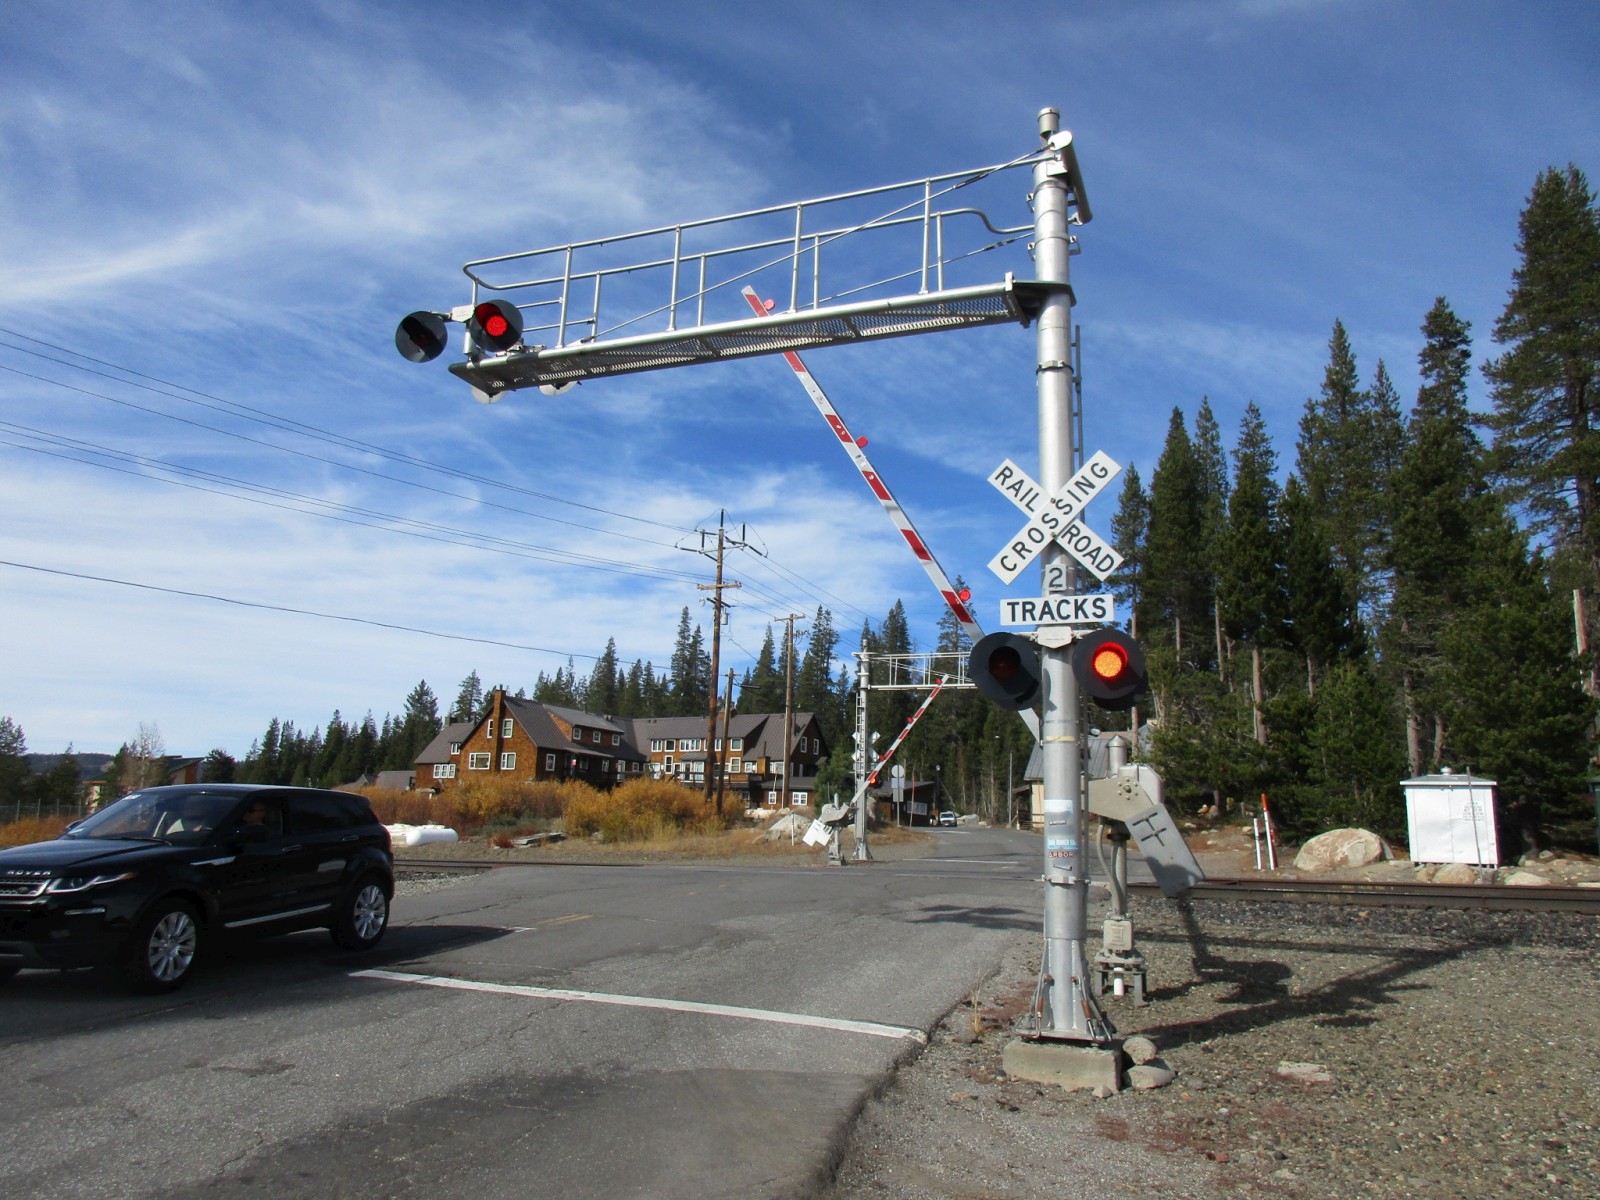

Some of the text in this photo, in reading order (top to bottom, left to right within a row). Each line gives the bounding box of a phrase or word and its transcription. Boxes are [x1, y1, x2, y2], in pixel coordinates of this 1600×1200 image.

[994, 465, 1115, 573] RAIL ROAD
[1000, 462, 1109, 572] CROSSING
[1006, 597, 1107, 622] TRACKS
[1048, 567, 1063, 588] 2
